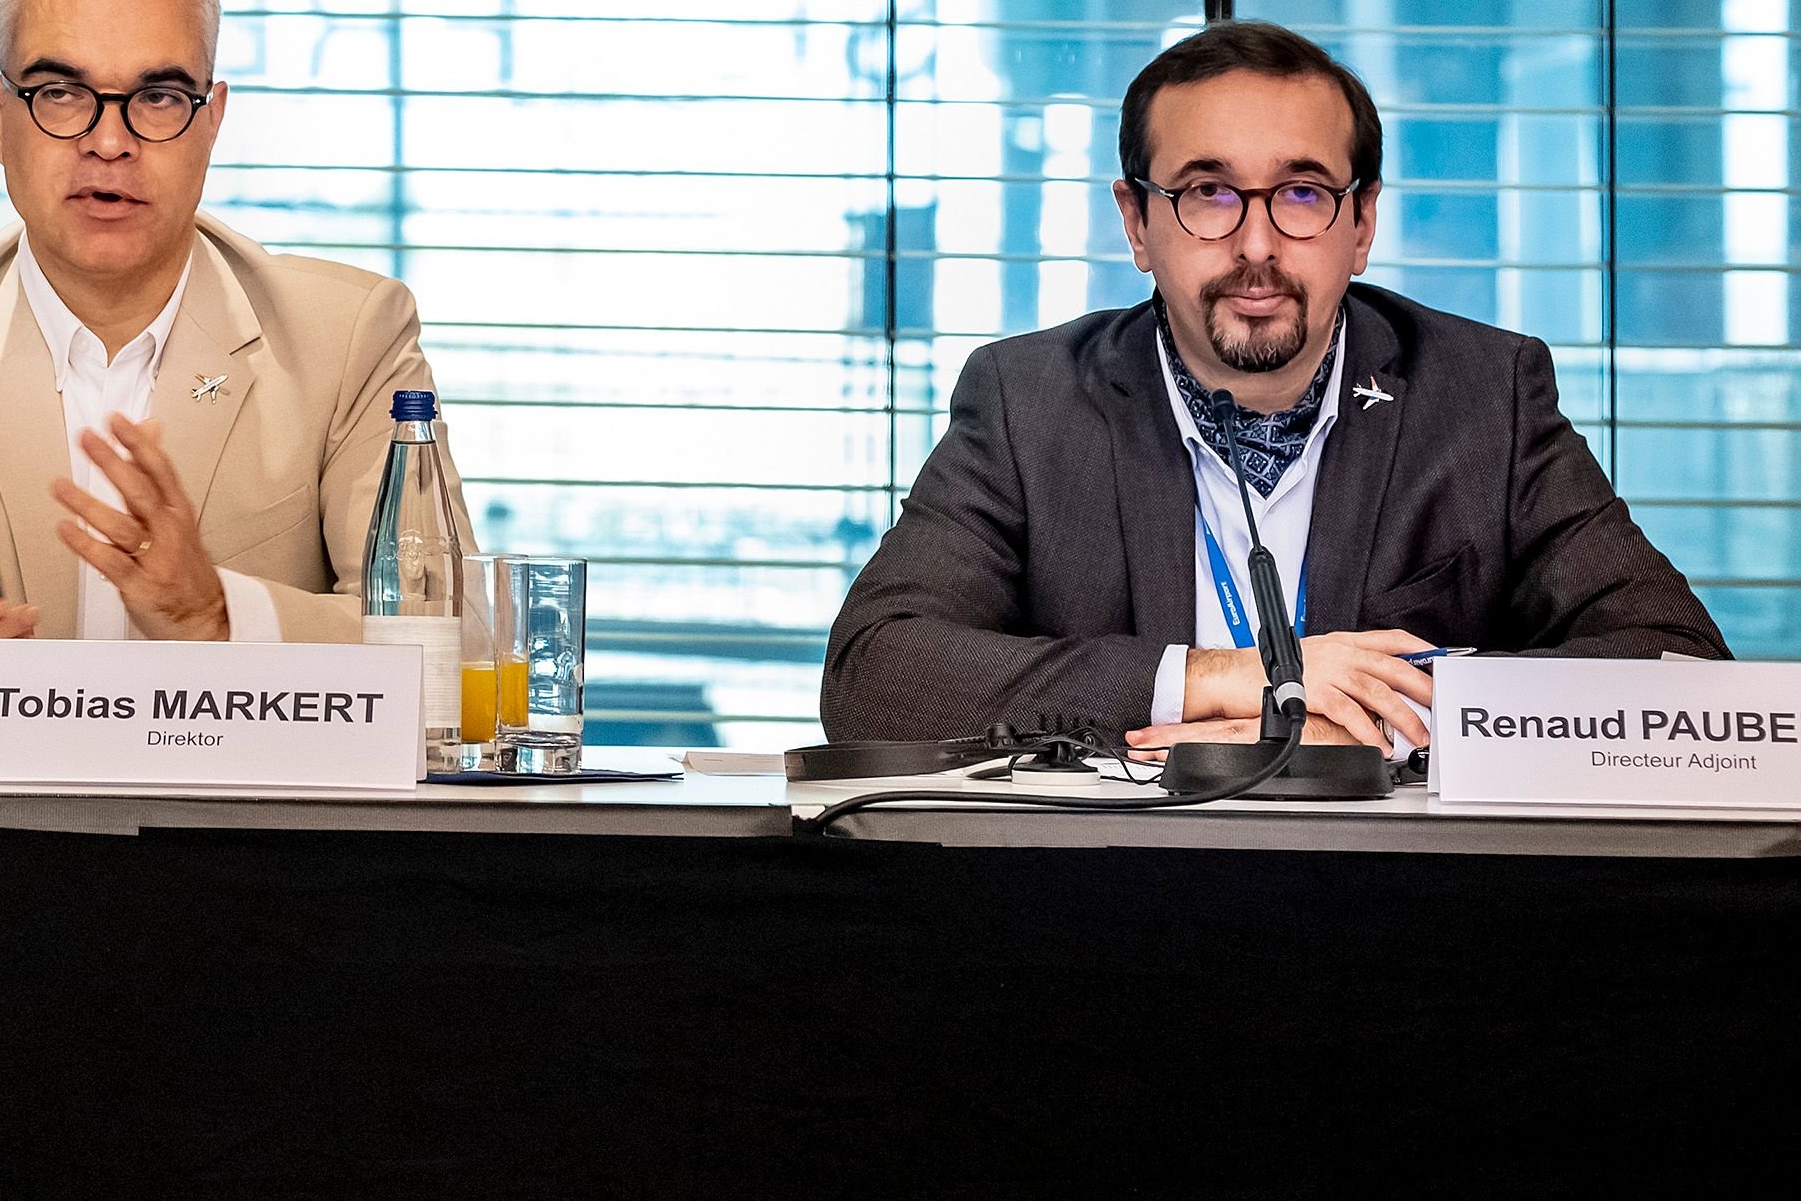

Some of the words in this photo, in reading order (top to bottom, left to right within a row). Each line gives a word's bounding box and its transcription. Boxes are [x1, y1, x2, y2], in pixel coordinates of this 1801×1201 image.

[152, 689, 384, 724] MARKERT
[147, 730, 224, 747] Direktor
[1460, 707, 1626, 740] Renaud
[1641, 709, 1801, 744] PAUBE
[1591, 751, 1683, 769] Directeur
[1687, 753, 1757, 773] Adjoint
